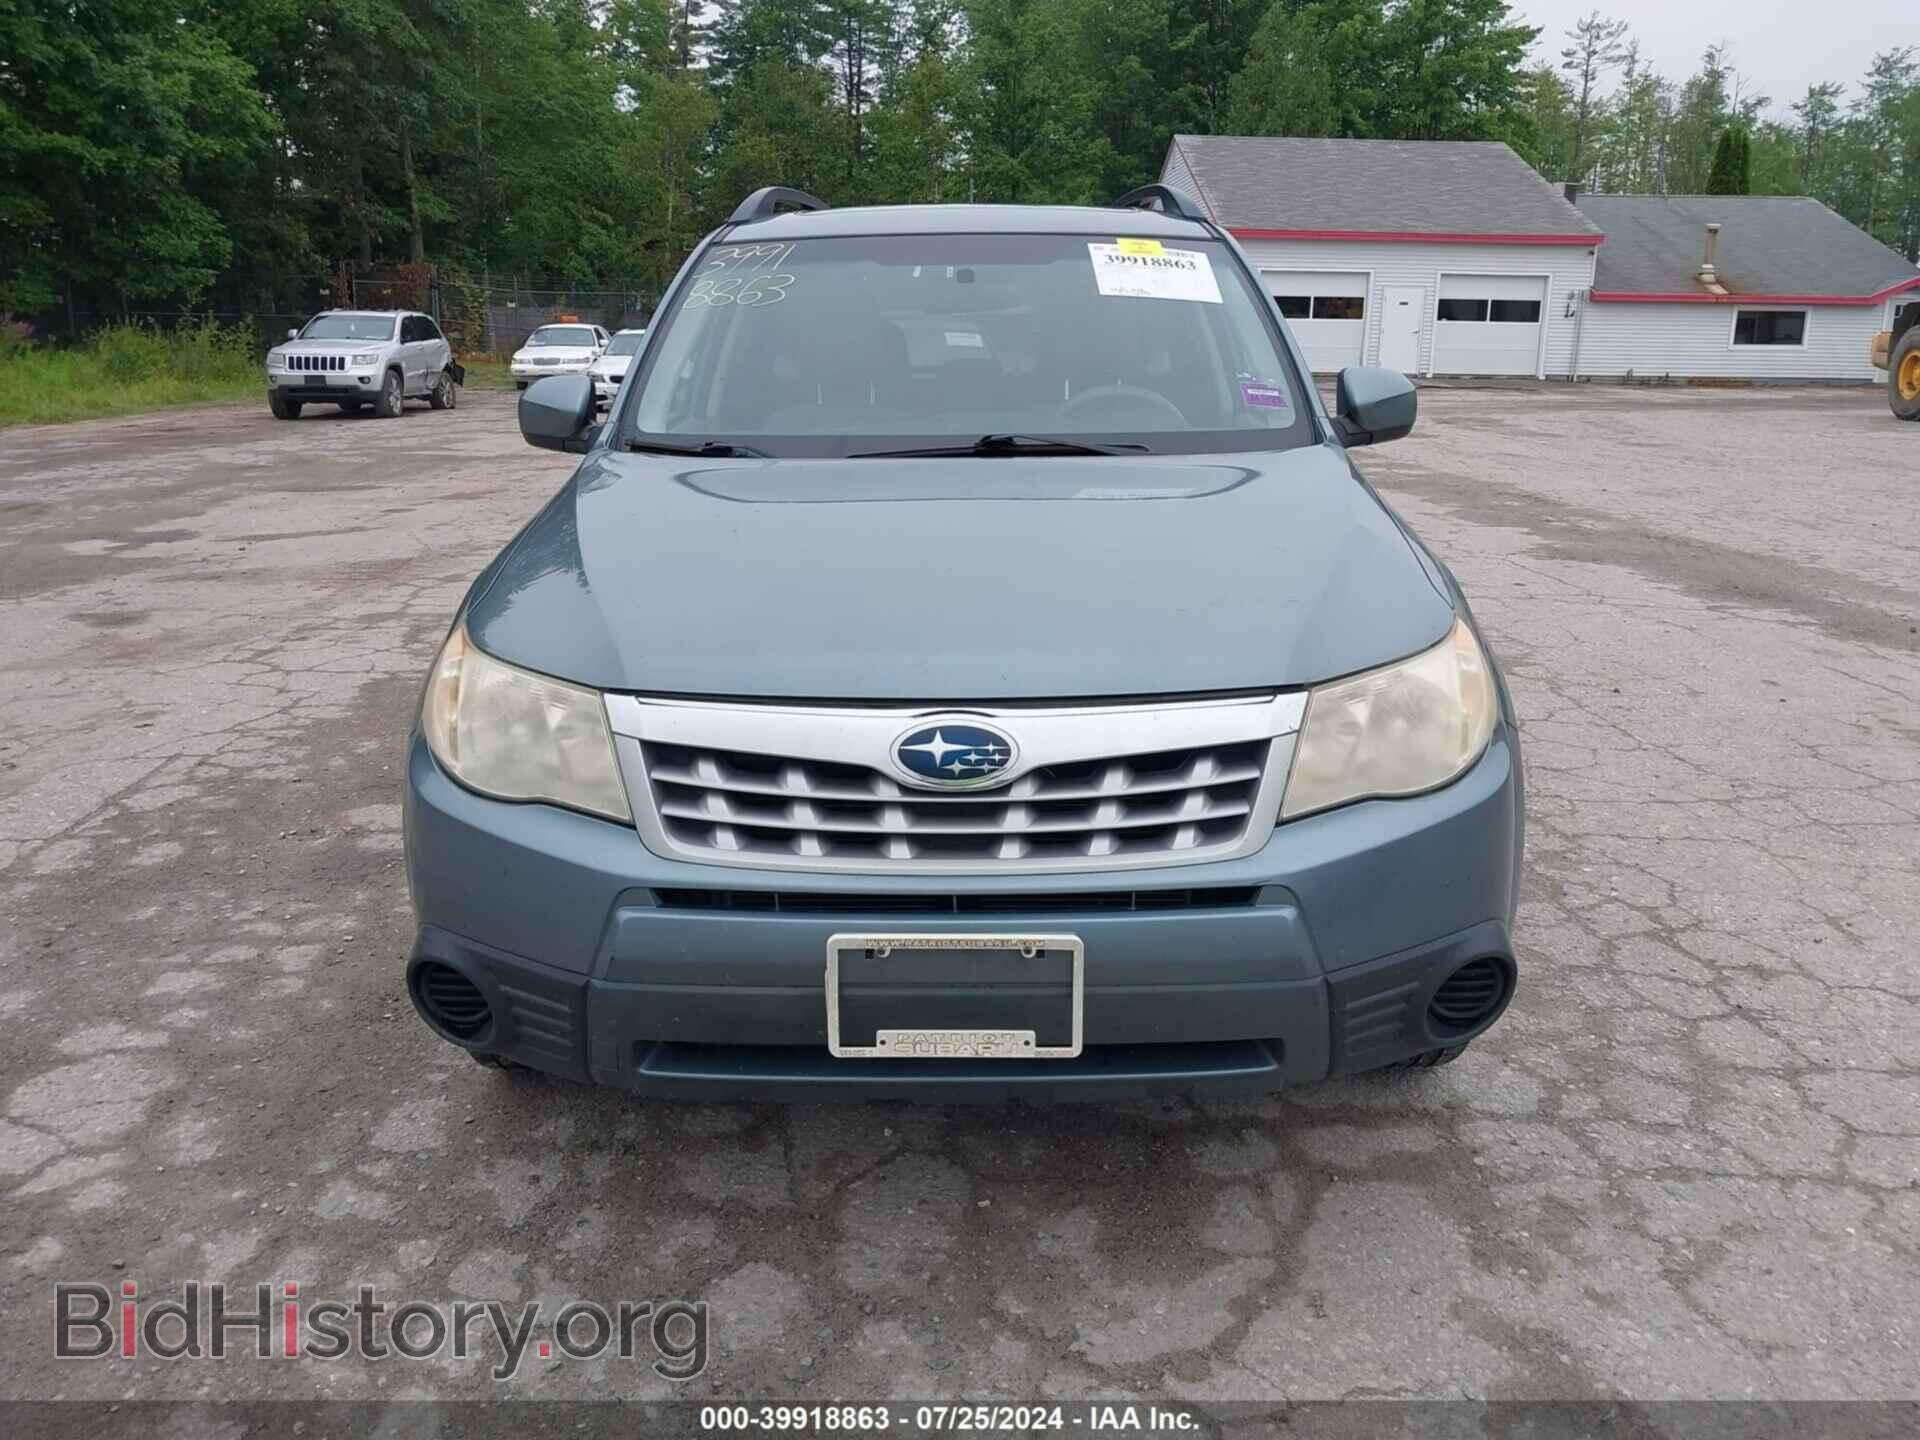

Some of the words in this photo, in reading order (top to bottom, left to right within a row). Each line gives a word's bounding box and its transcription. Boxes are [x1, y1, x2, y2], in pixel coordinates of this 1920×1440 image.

[693, 243, 796, 278] 3991
[1104, 254, 1196, 271] 39918863
[682, 274, 796, 309] 8863
[896, 1032, 1016, 1043] PATRIOT
